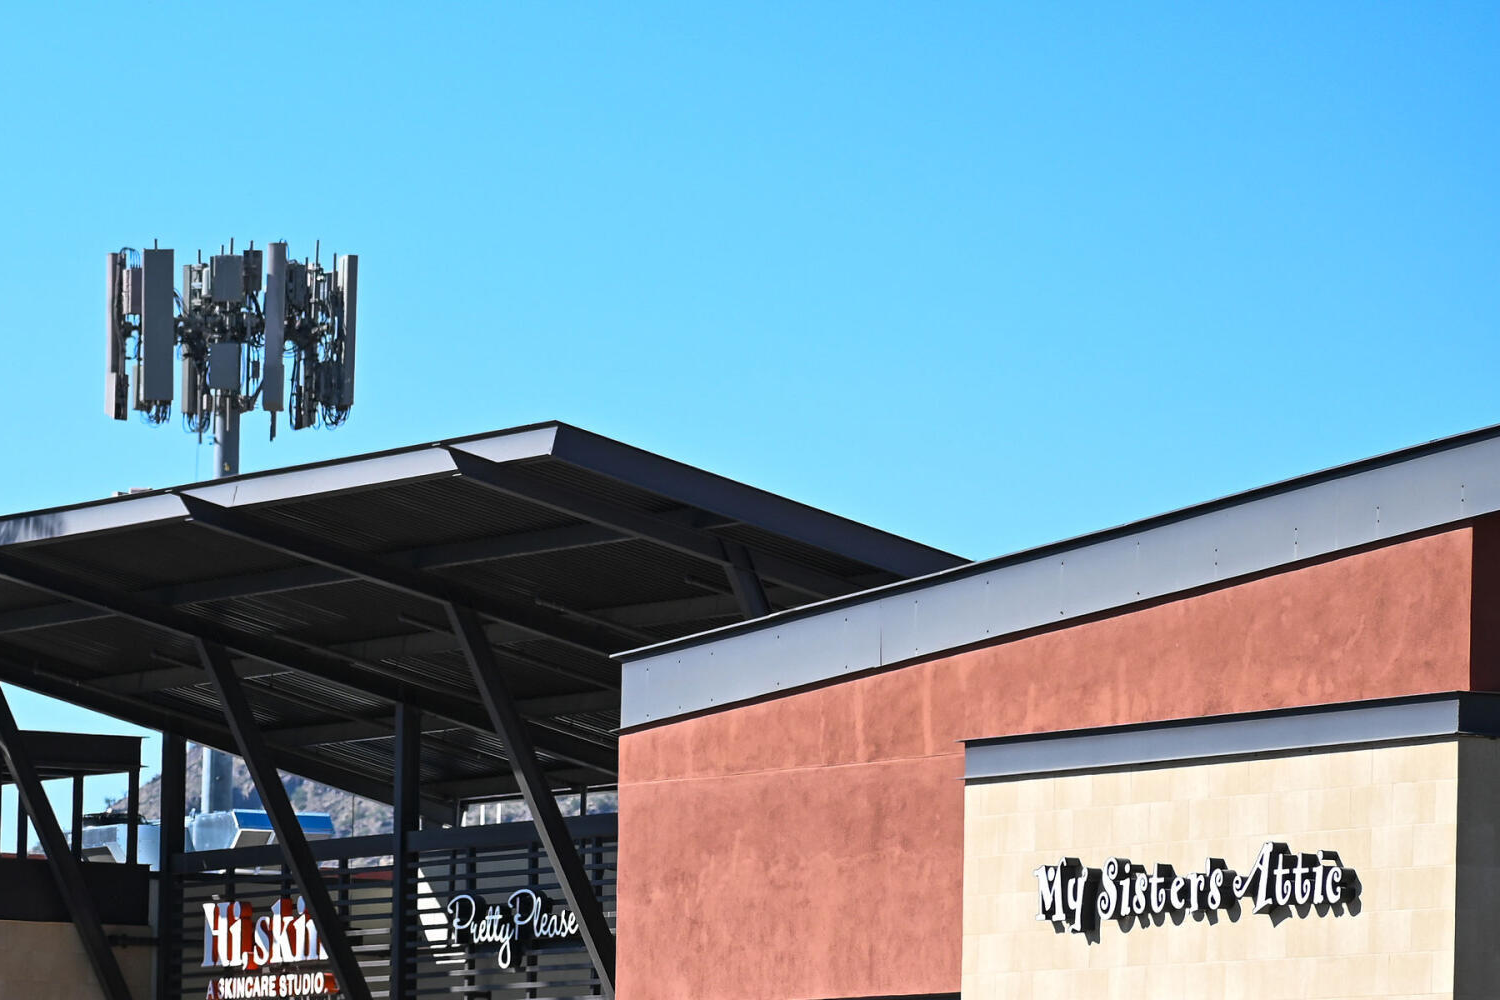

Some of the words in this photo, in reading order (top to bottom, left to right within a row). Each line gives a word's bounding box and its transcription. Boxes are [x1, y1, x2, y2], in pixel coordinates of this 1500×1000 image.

[1033, 857, 1089, 933] My
[1100, 856, 1225, 918] Sister's
[1233, 841, 1343, 907] Attic
[447, 894, 515, 969] Pretty
[508, 888, 580, 938] Please
[206, 979, 215, 1000] A
[217, 974, 278, 1000] SKINCARE
